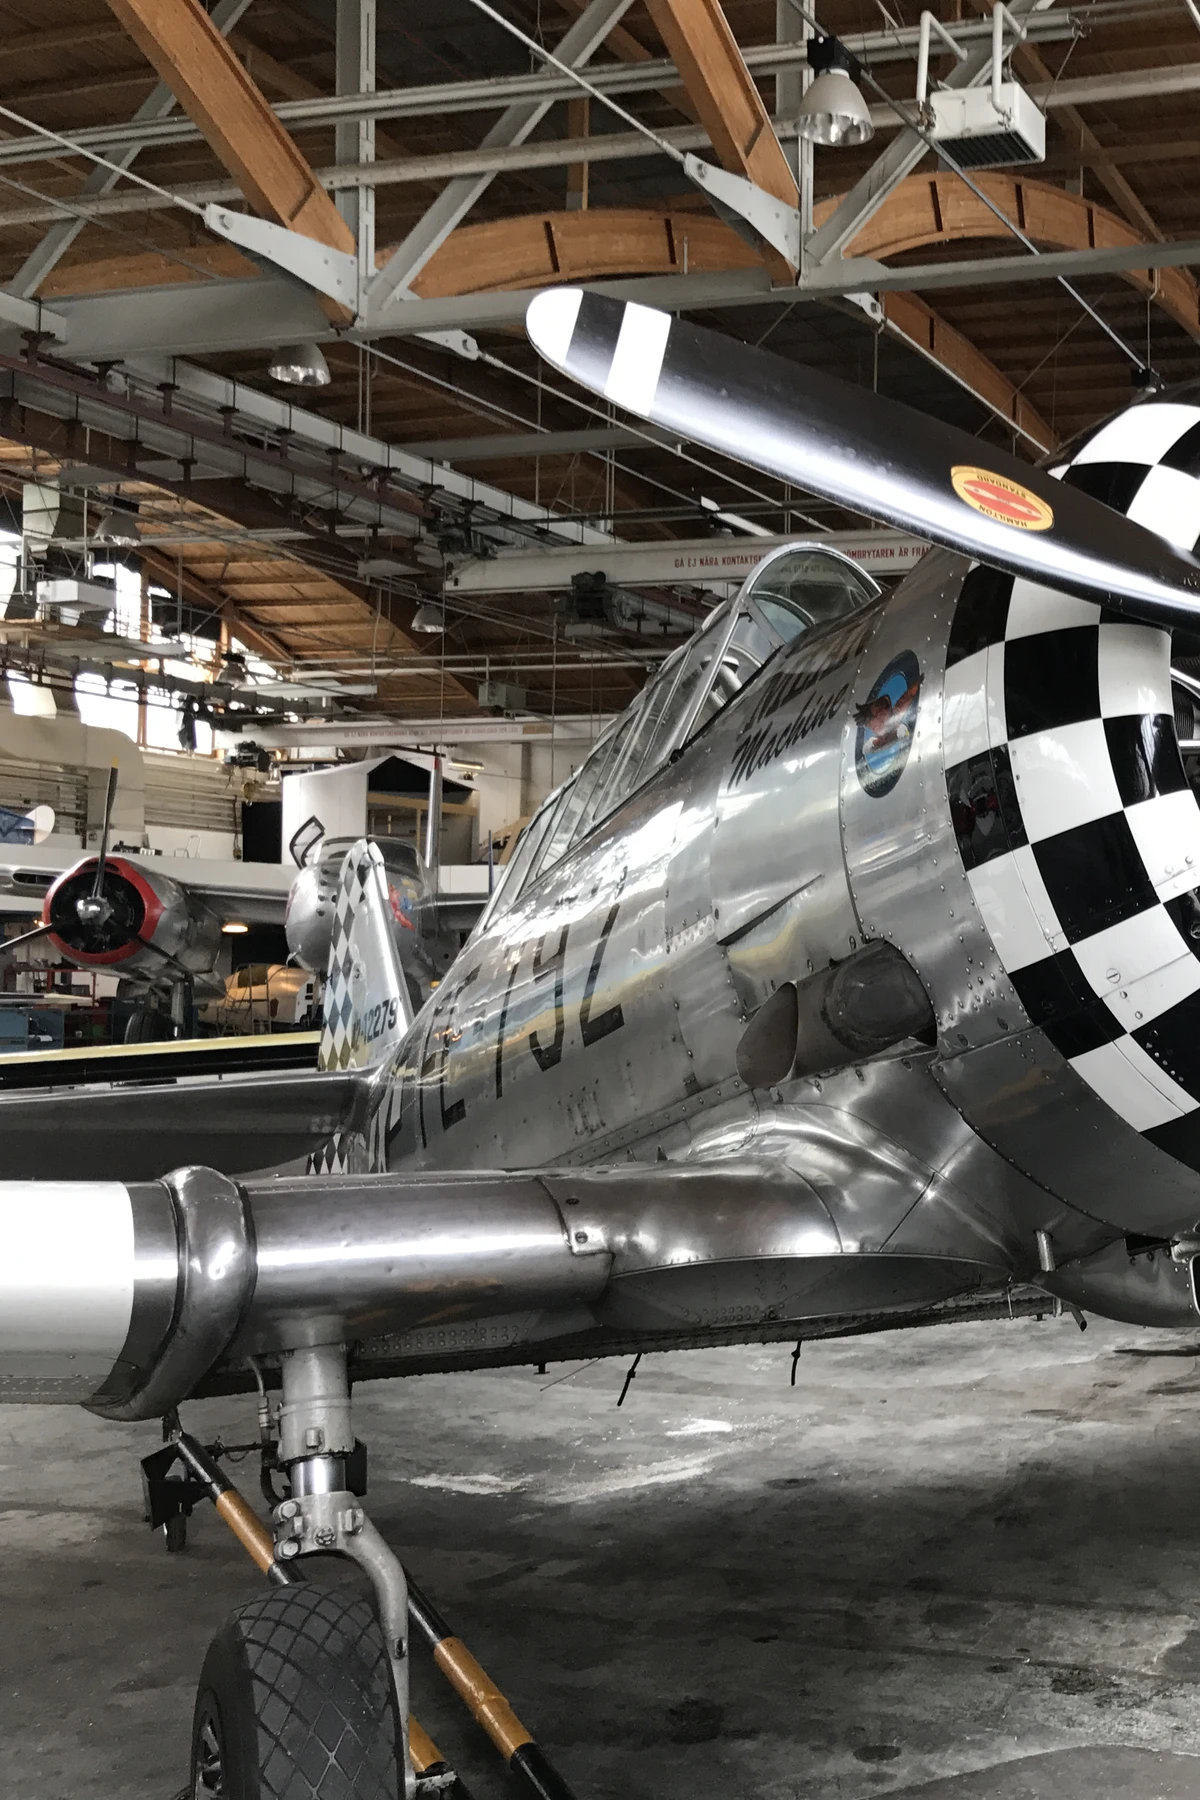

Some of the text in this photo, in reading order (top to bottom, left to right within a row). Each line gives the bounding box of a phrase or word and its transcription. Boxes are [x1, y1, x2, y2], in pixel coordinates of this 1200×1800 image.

[977, 474, 1026, 499] STANDARD
[979, 504, 1028, 528] HAMILTON
[687, 557, 696, 568] EJ
[727, 683, 850, 793] Machine
